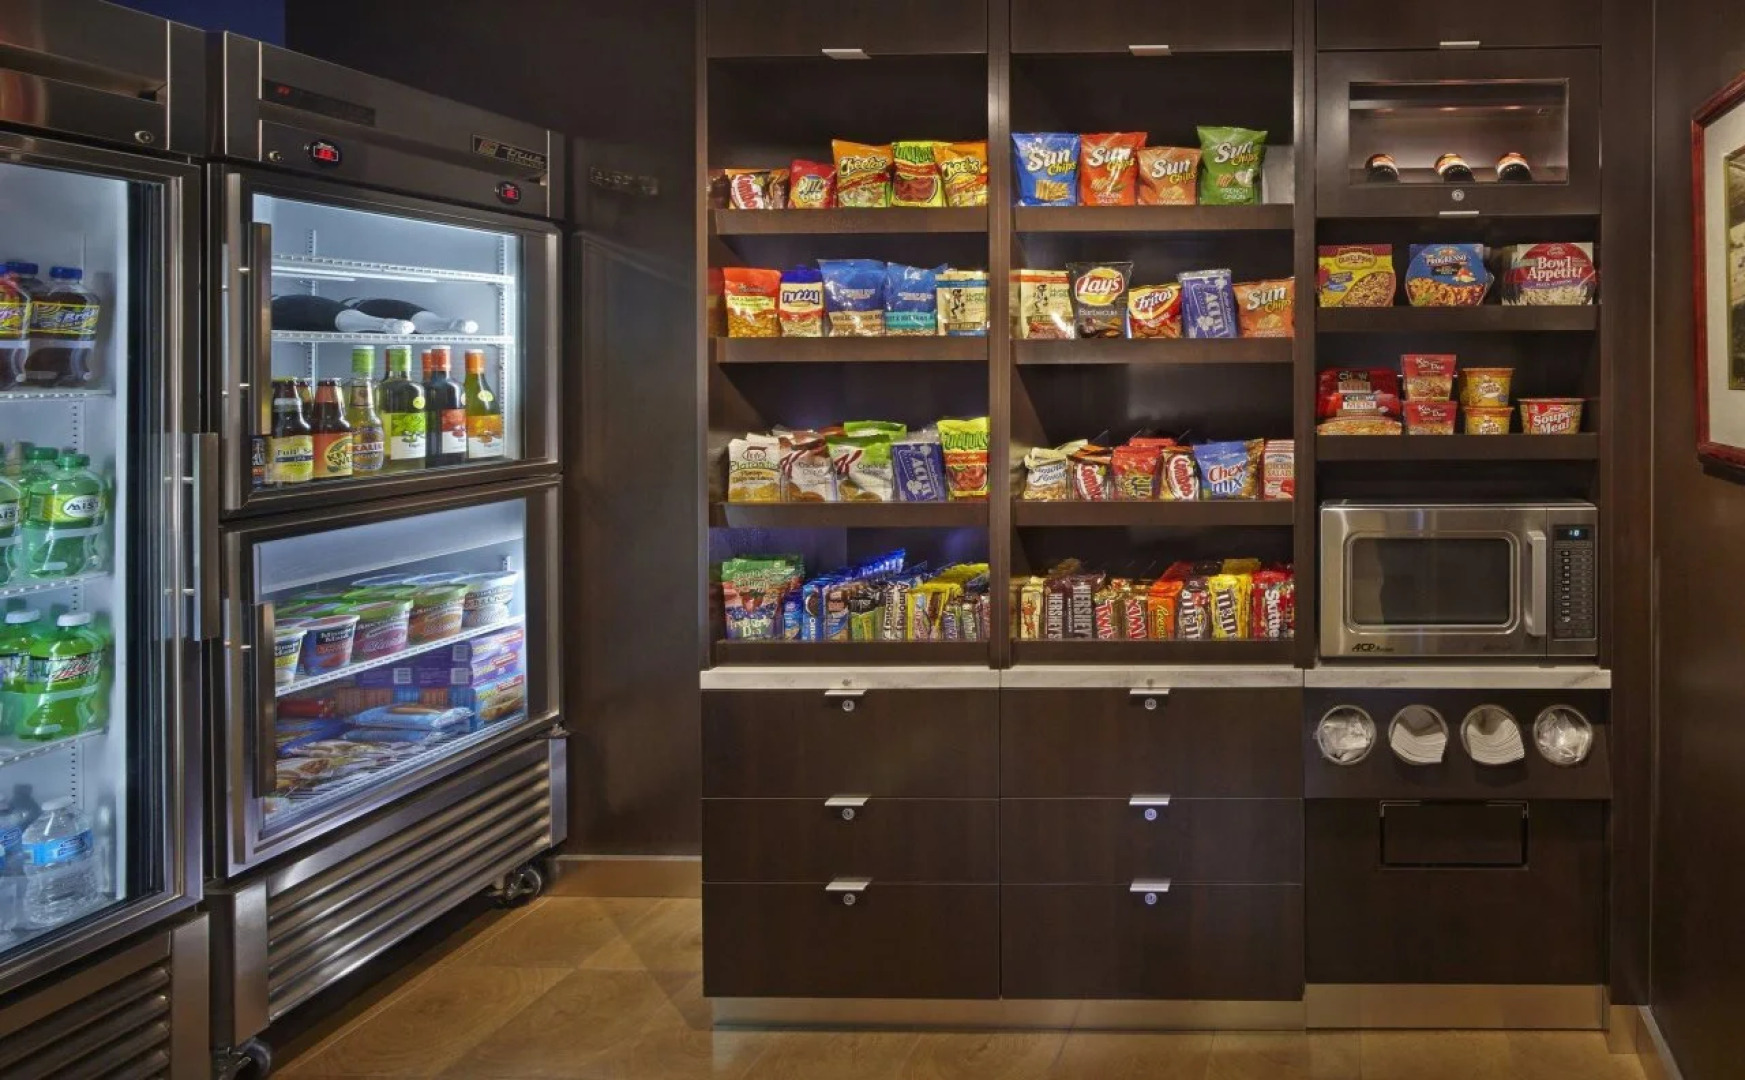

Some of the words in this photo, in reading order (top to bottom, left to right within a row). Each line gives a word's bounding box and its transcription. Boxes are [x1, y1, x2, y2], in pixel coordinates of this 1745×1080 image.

[1026, 147, 1071, 172] Sun
[1087, 146, 1132, 168] Sun
[1214, 141, 1254, 163] Sun
[1151, 159, 1191, 178] Sun
[1537, 256, 1572, 270] Bowl
[1134, 287, 1173, 311] Fritos
[1246, 286, 1288, 311] Sun
[1533, 410, 1574, 427] Souper
[1207, 460, 1245, 485] Chex
[1047, 592, 1063, 639] HERSHEY'S
[1264, 588, 1281, 638] Skittle
